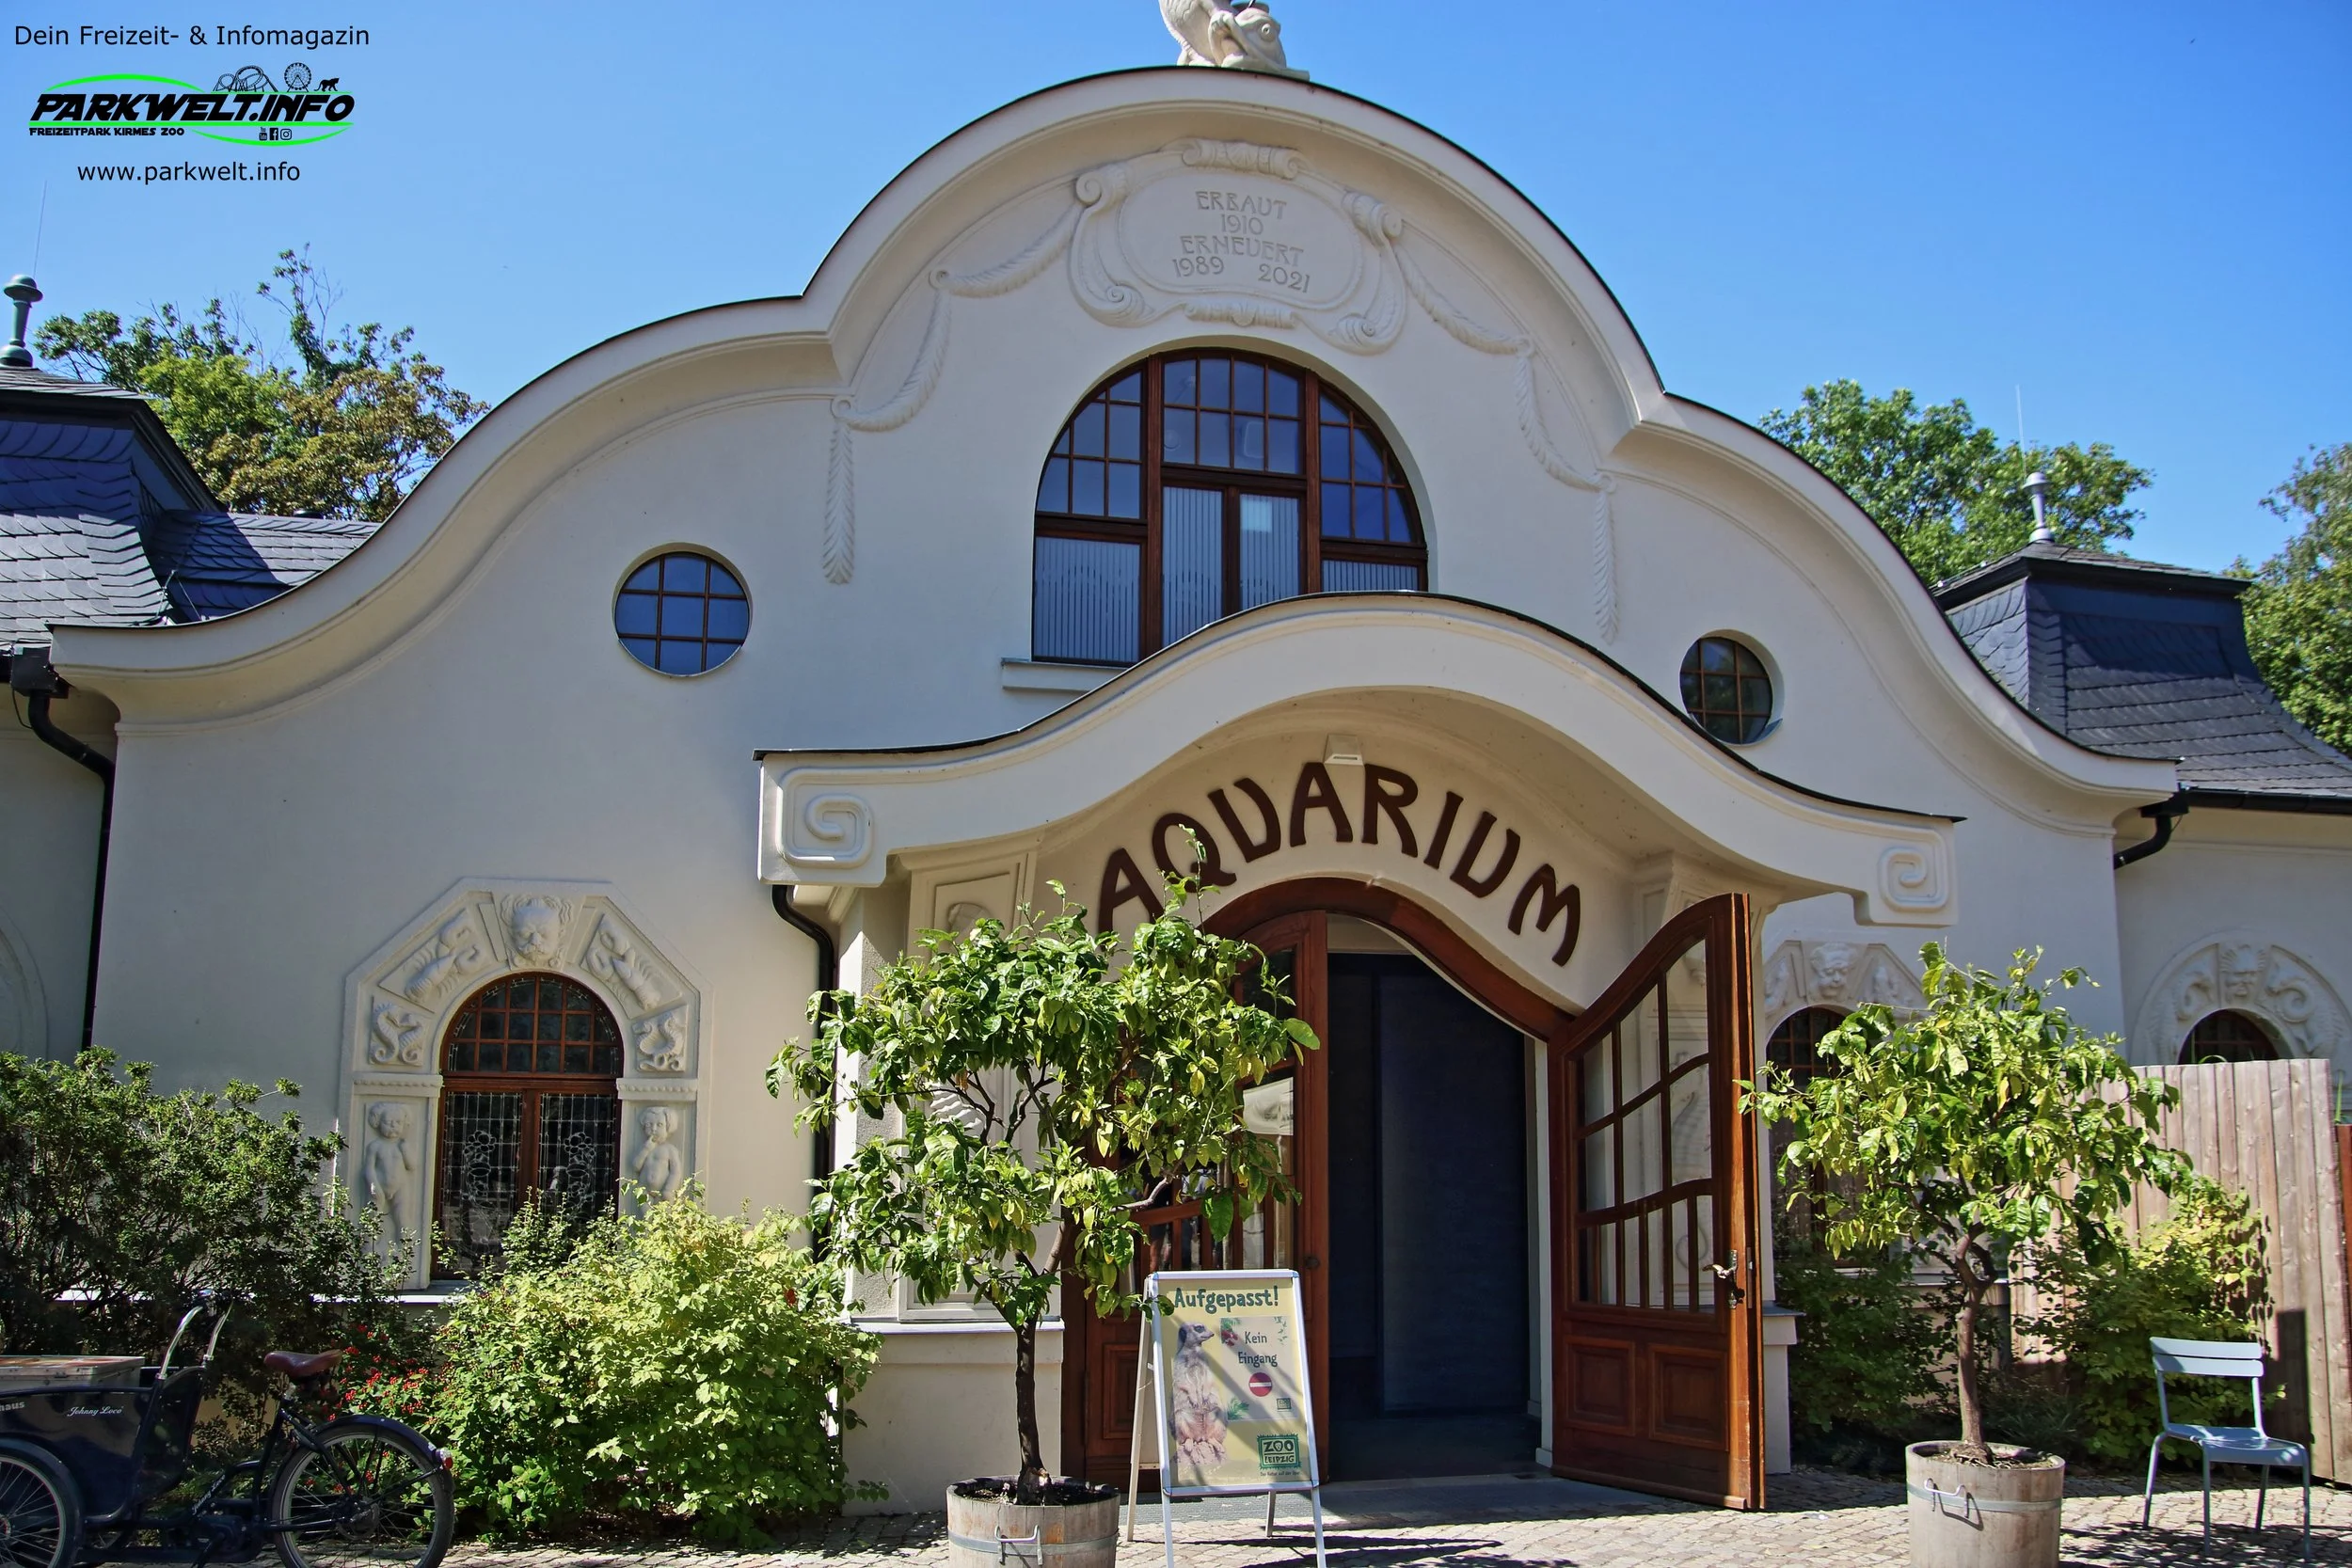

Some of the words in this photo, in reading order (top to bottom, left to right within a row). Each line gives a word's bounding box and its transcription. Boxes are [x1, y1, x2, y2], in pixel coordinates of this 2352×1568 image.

[1196, 191, 1287, 220] ERBAUT
[1221, 214, 1263, 235] 1910
[1180, 235, 1304, 267] ERNEUERT
[1172, 256, 1225, 277] 1989
[1258, 263, 1310, 293] 2021
[1098, 762, 1581, 967] AQUARIUM
[1174, 1285, 1279, 1315] Aufgepasst!
[1245, 1331, 1267, 1344] Kein
[1238, 1352, 1278, 1368] Eingang
[67, 1406, 99, 1417] Johnny
[1263, 1440, 1295, 1452] ZOO
[1264, 1455, 1295, 1464] LEIPZIG
